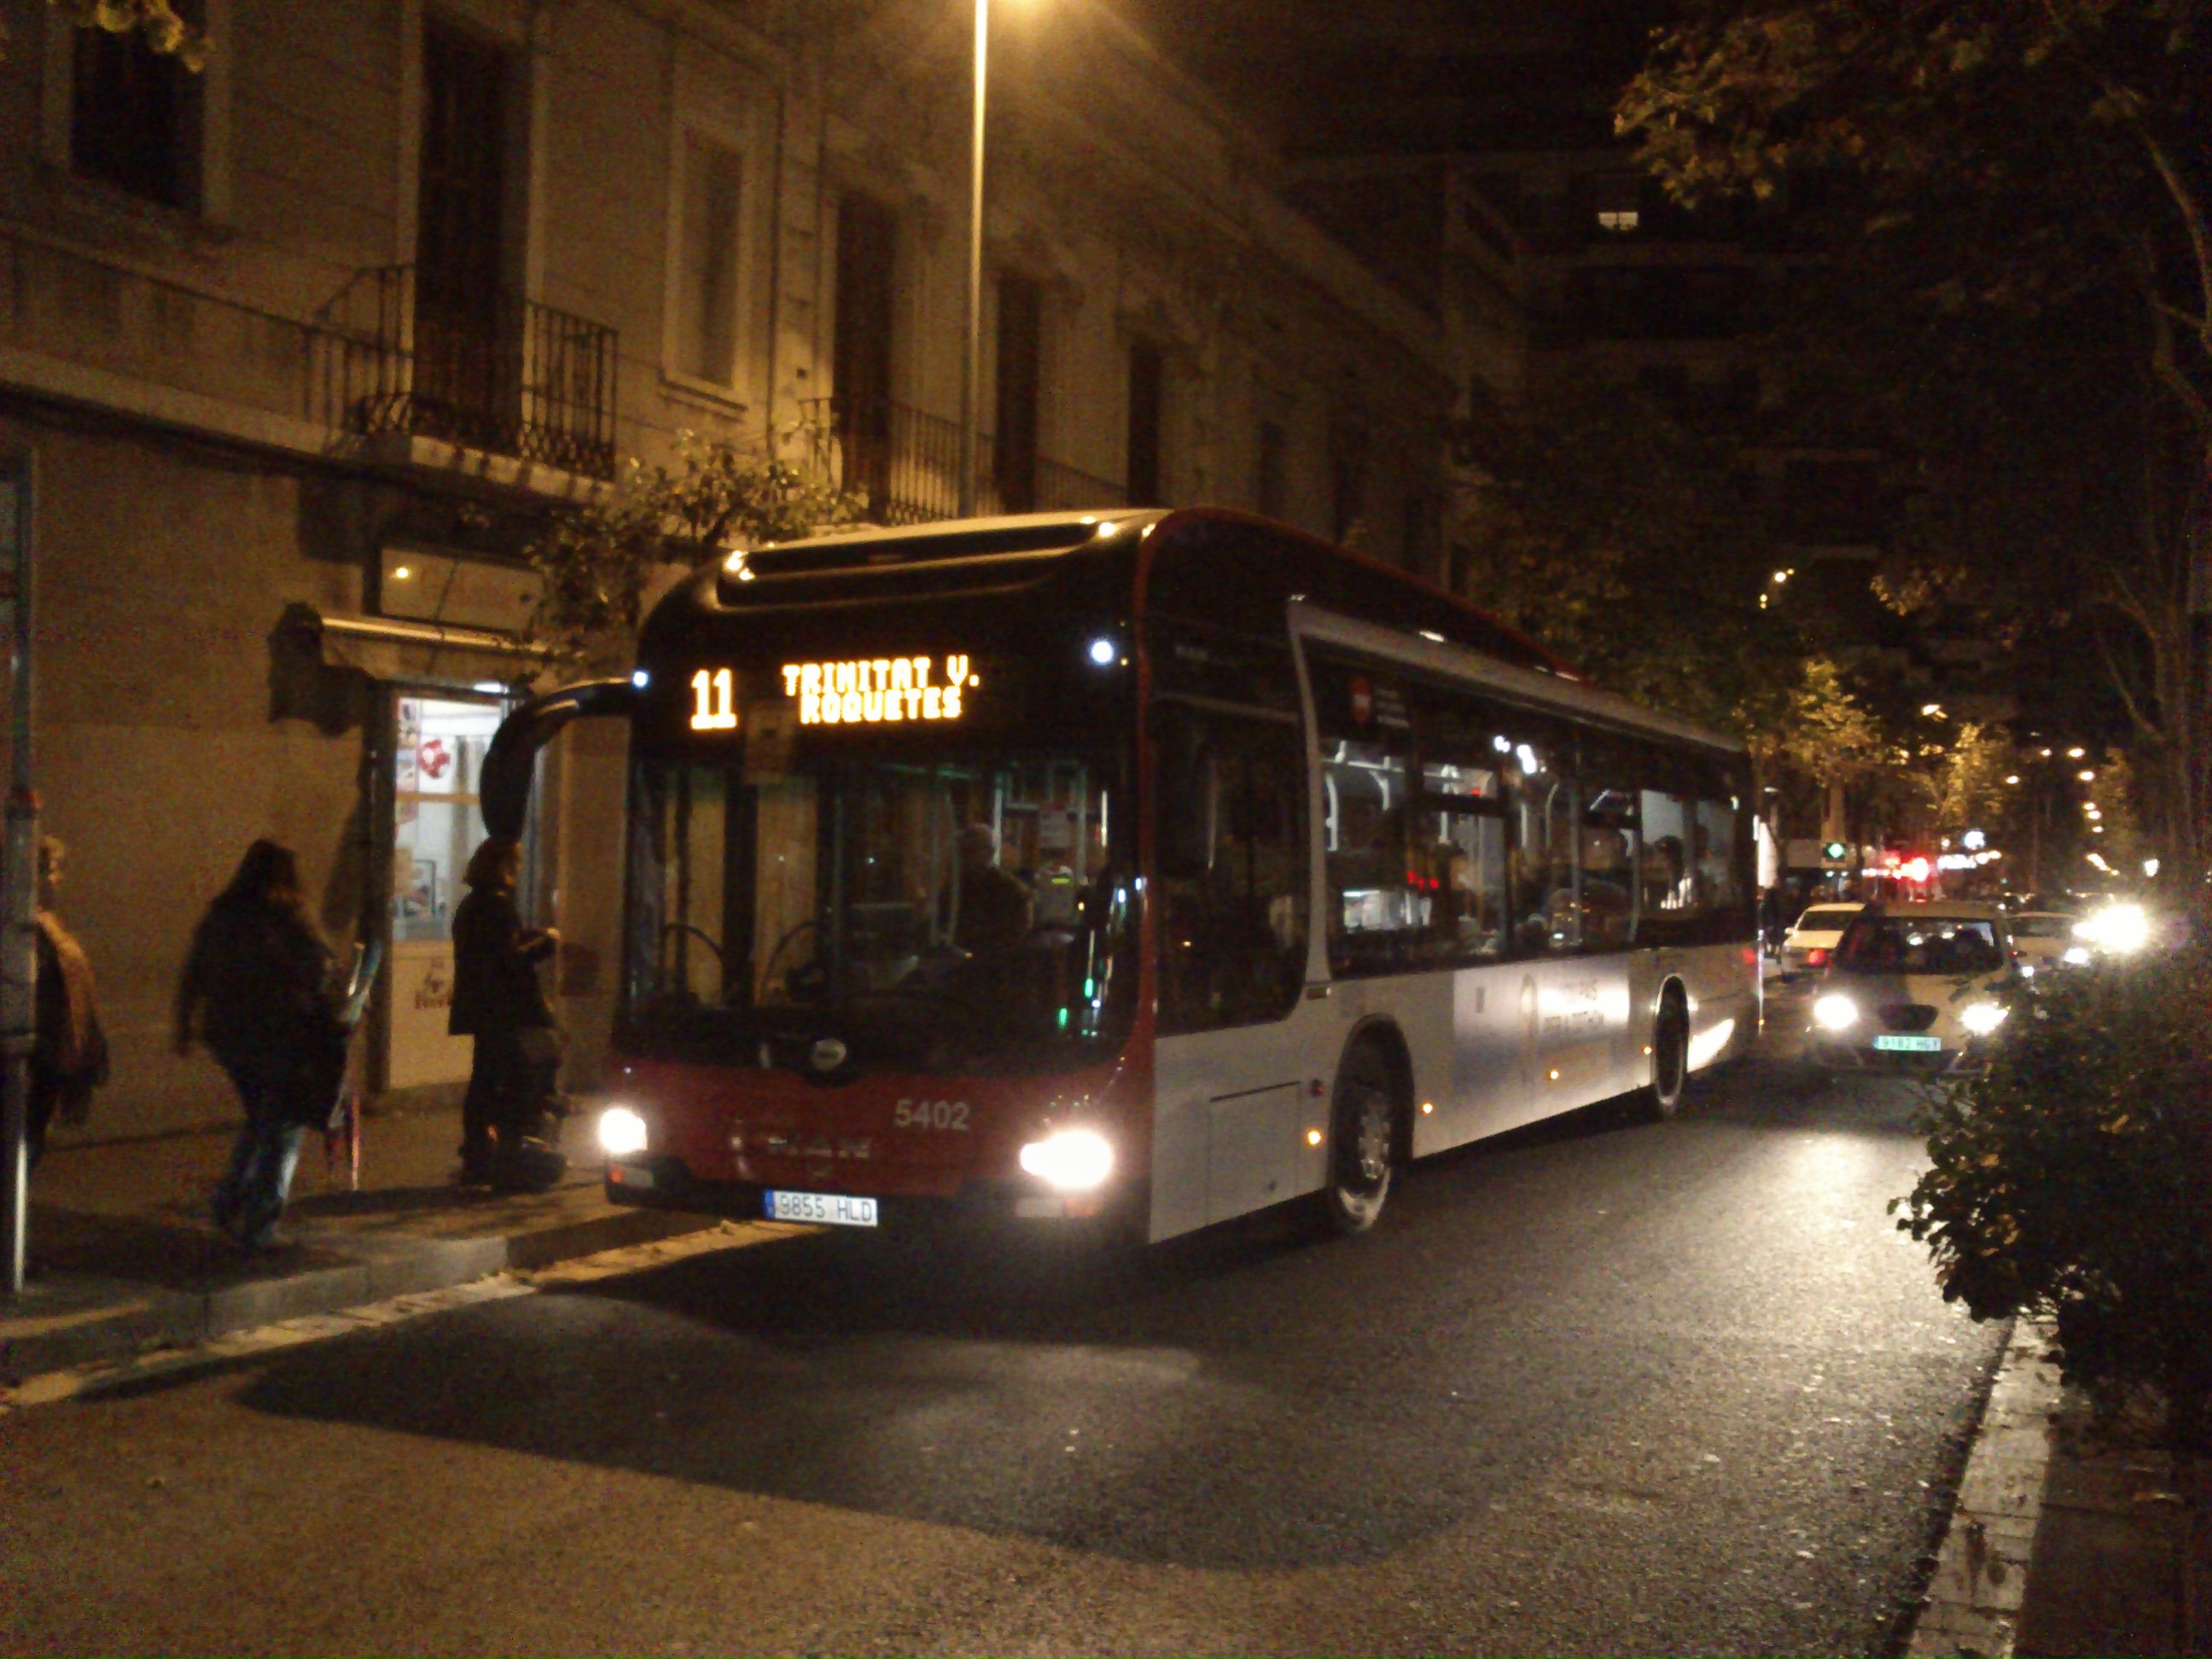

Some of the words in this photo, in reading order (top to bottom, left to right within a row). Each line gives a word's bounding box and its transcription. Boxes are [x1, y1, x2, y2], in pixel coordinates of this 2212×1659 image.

[691, 668, 736, 730] 11
[800, 686, 962, 725] ROQUETES
[895, 1098, 969, 1131] 5402
[837, 1199, 872, 1221] HLD
